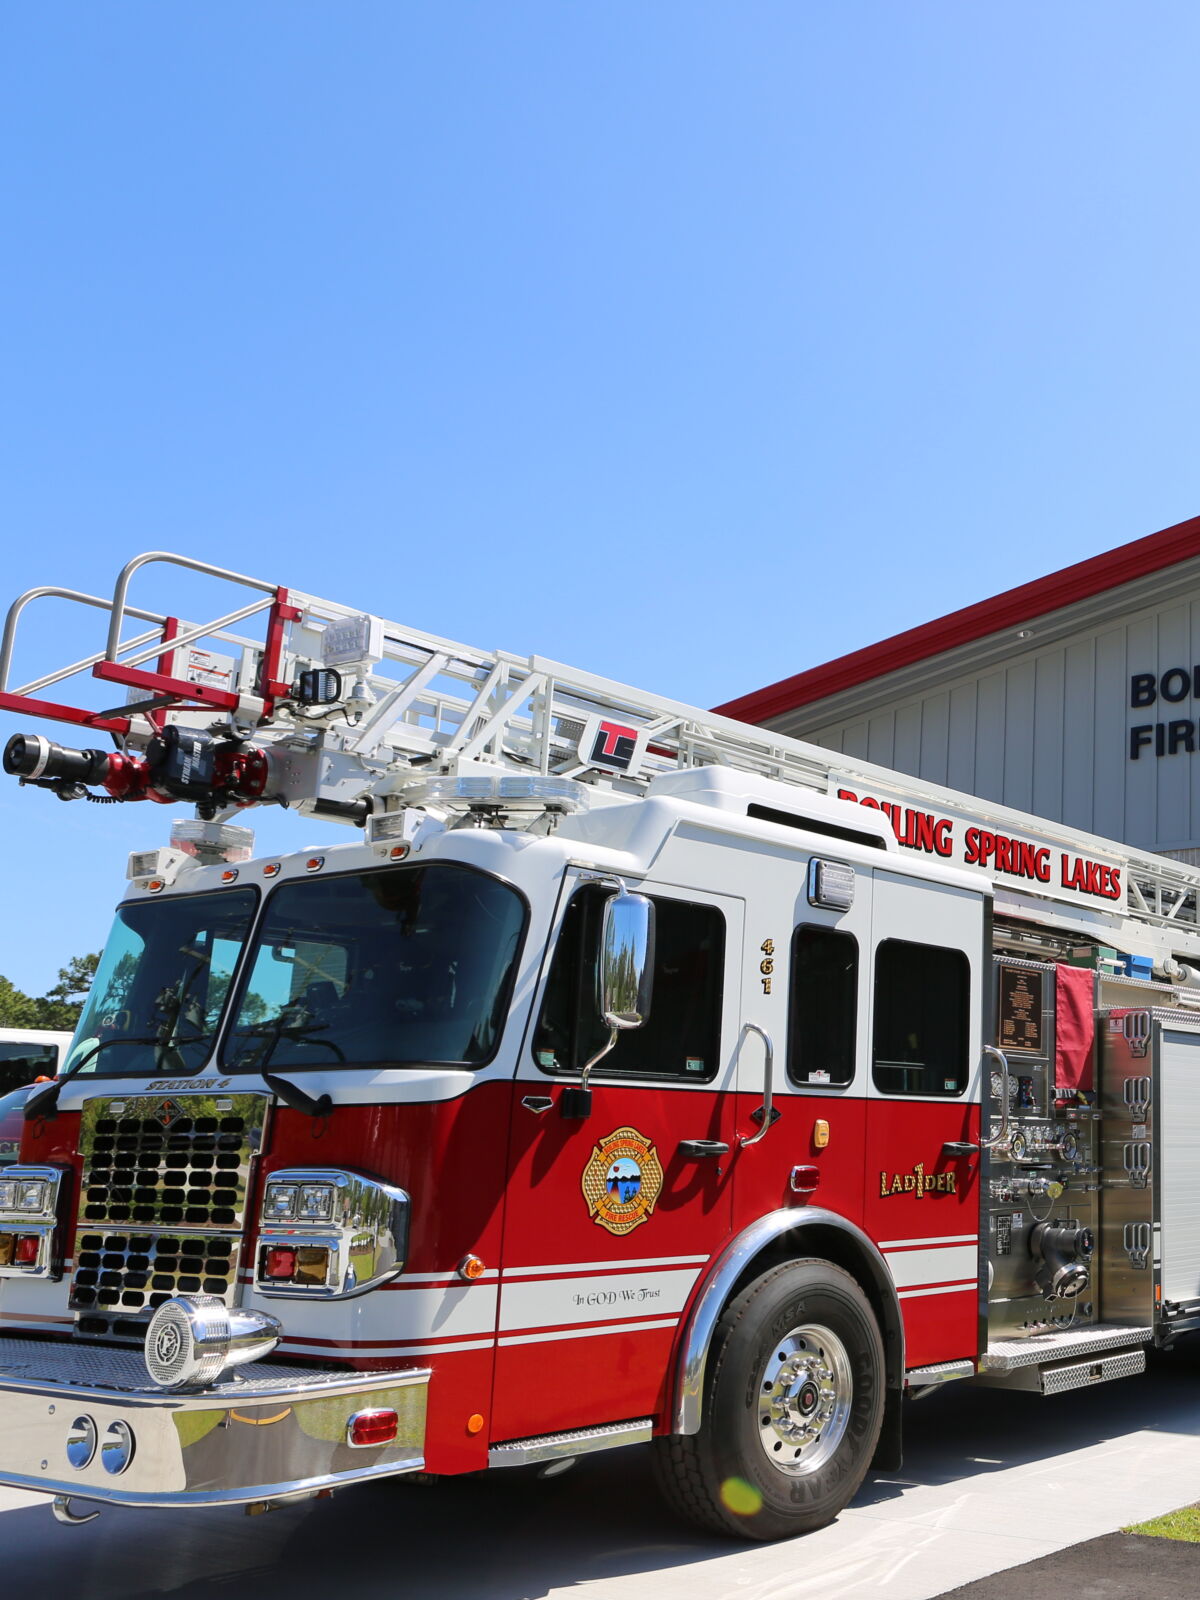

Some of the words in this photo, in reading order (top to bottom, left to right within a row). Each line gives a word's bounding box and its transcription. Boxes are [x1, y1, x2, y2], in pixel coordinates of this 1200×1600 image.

[964, 826, 1050, 883] SPRING
[1061, 853, 1121, 900] LAKES
[145, 1079, 217, 1090] STATION
[217, 1078, 232, 1088] 4
[605, 1211, 618, 1221] FIRE
[618, 1211, 639, 1222] RESCUE
[573, 1294, 584, 1305] In
[587, 1291, 617, 1305] GOD
[619, 1290, 635, 1301] We
[637, 1288, 660, 1301] Trust
